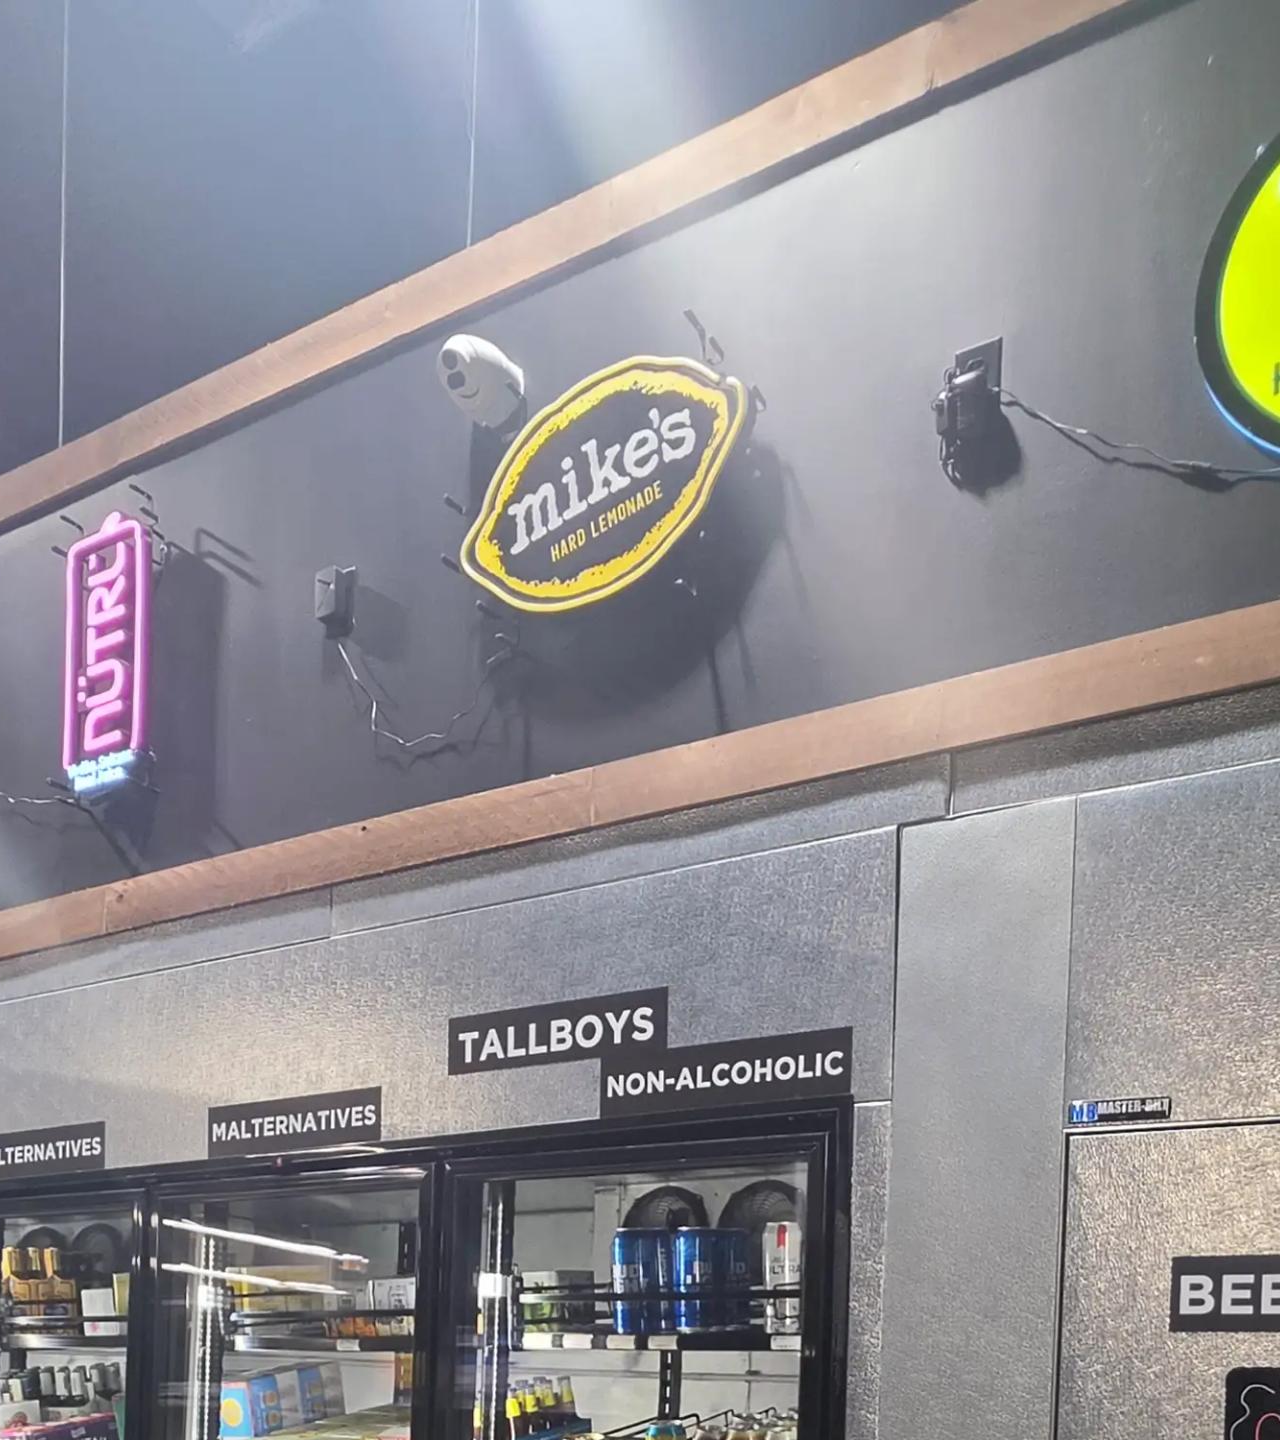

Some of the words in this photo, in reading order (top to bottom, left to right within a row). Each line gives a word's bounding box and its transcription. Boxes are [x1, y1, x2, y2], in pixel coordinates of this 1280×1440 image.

[506, 407, 696, 555] mike's
[549, 528, 587, 562] HARD
[590, 480, 663, 538] LEMONADE
[458, 1006, 655, 1064] TALLBOYS
[605, 1050, 845, 1098] NON-ALCOHOLIC
[211, 1103, 377, 1143] MALTERNATIVES
